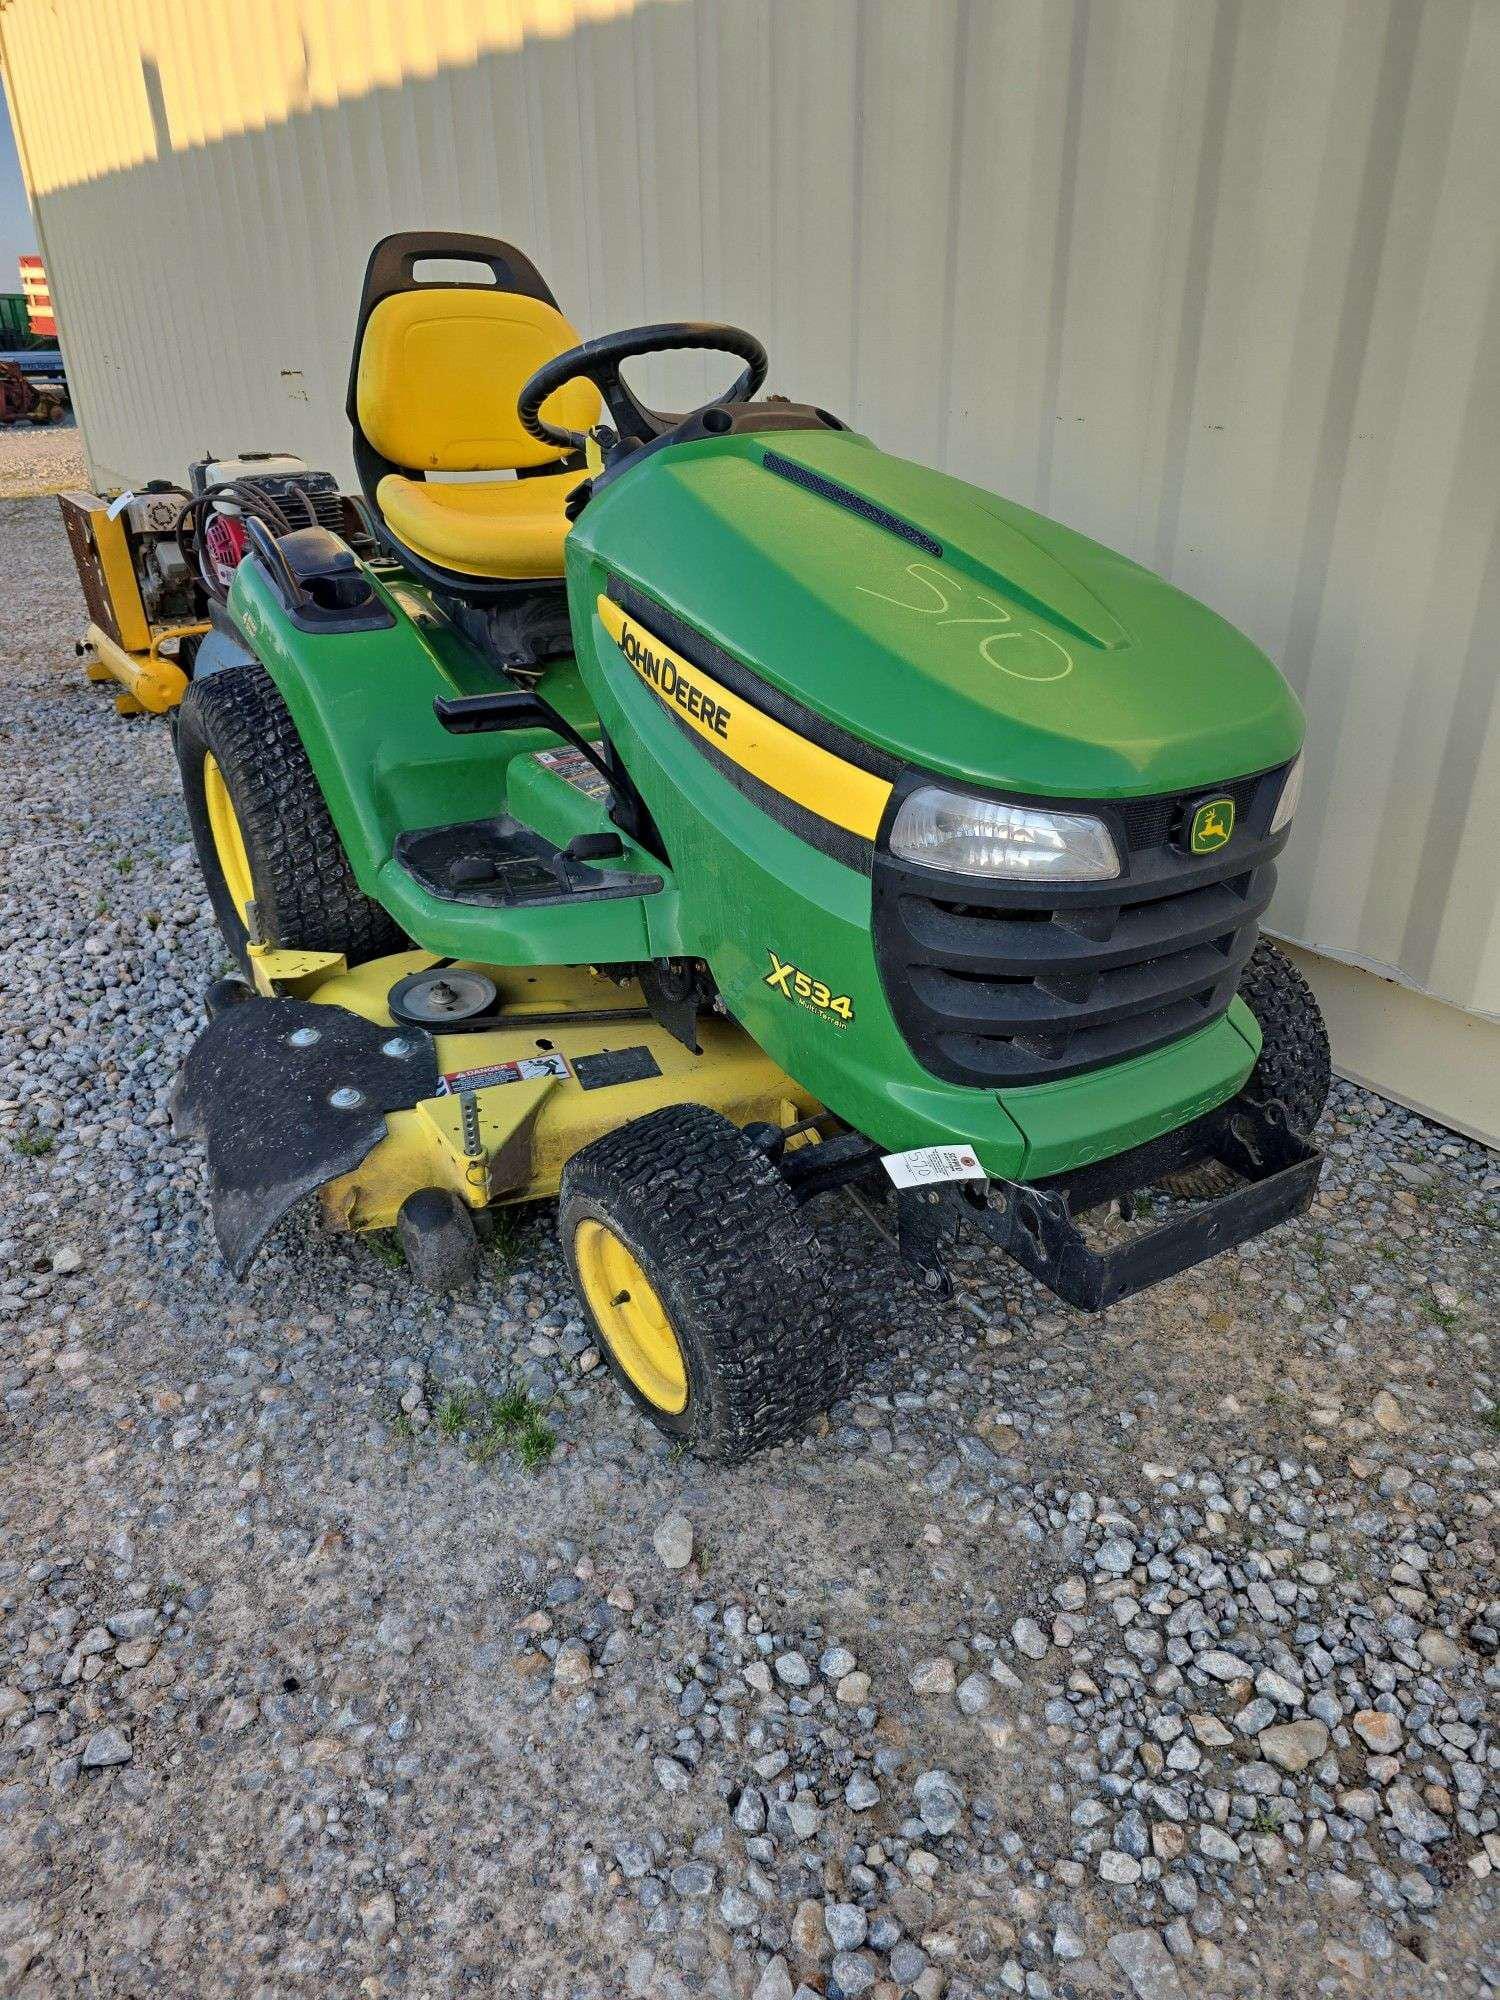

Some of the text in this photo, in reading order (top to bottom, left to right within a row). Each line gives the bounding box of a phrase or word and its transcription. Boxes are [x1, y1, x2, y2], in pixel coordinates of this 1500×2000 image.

[617, 621, 732, 740] JOHN DEERE
[763, 946, 855, 1021] X534
